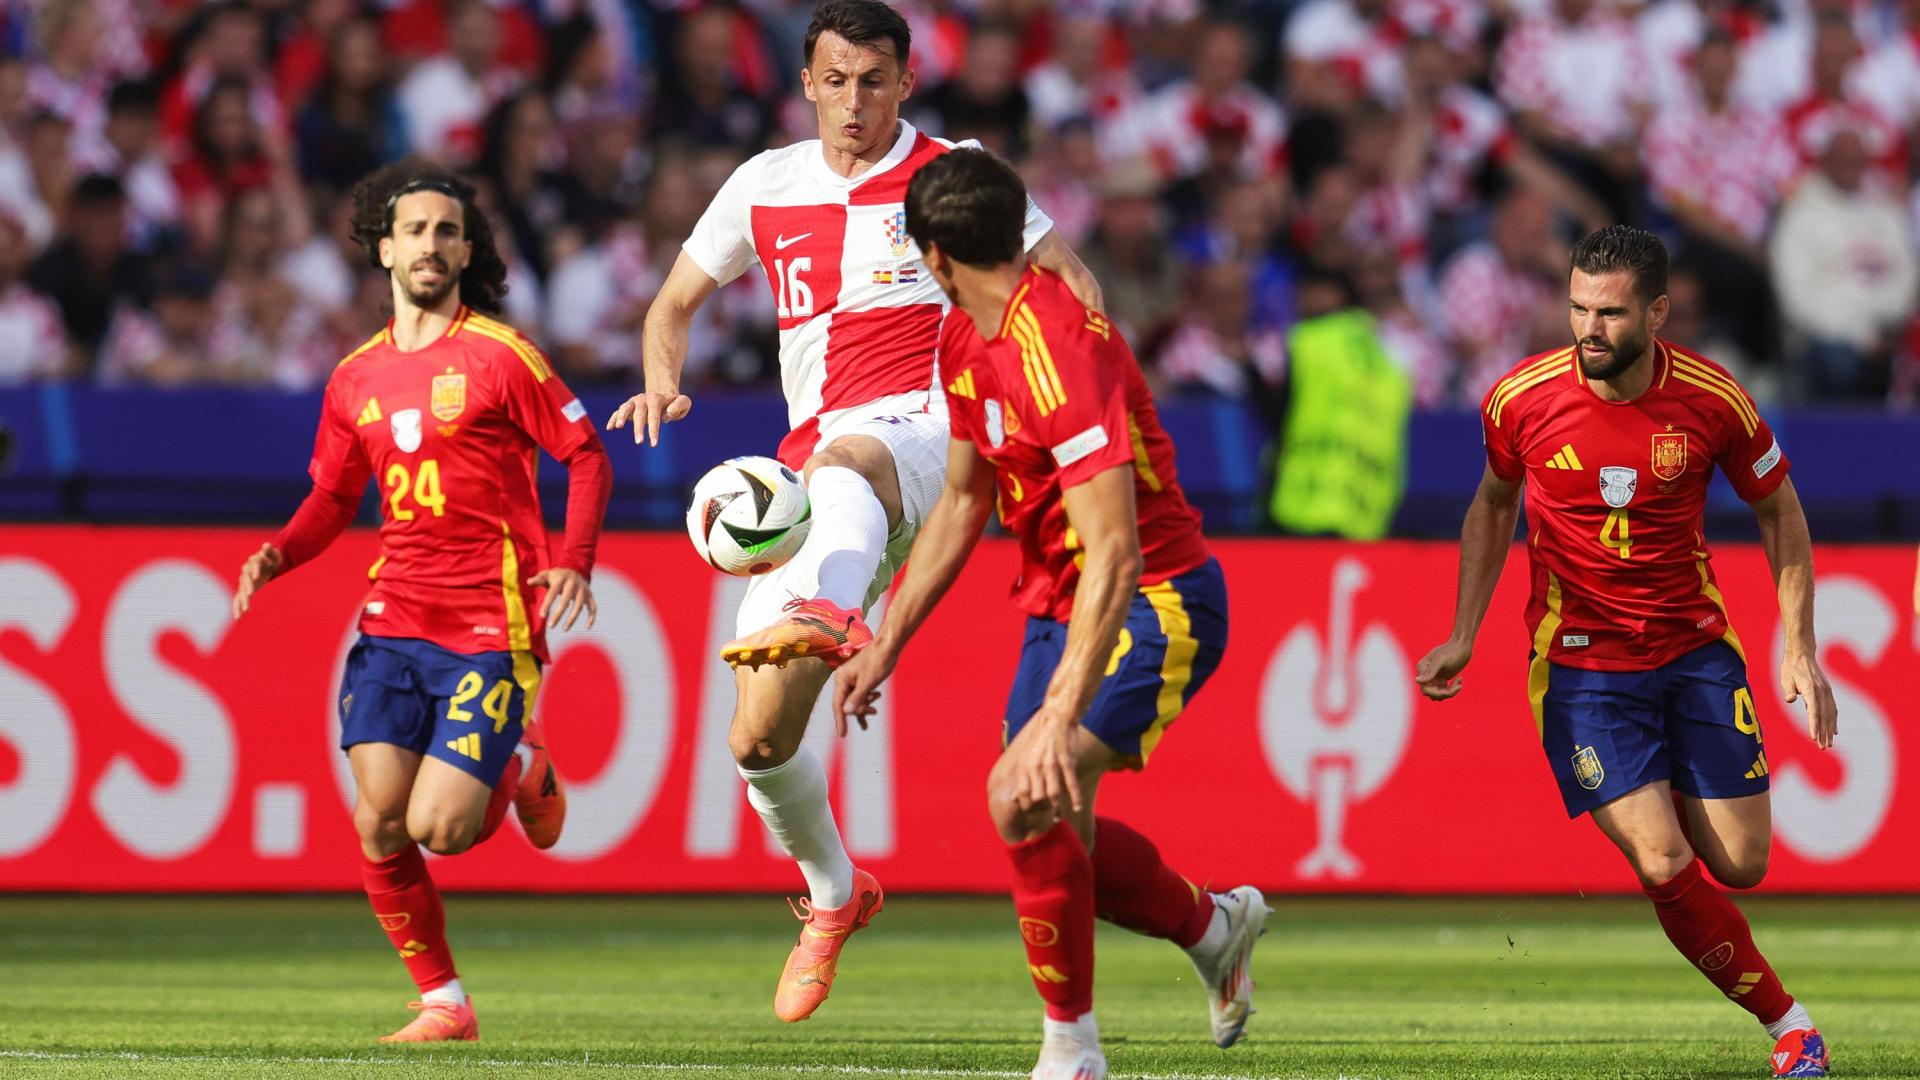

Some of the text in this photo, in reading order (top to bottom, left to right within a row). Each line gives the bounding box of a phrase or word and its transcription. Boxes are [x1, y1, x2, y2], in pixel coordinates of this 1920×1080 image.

[774, 257, 814, 318] 16
[386, 459, 446, 521] 24
[1600, 508, 1634, 559] 4
[0, 556, 897, 863] SS.OM
[446, 671, 513, 734] 24
[1735, 686, 1762, 745] 4
[1771, 573, 1920, 864] S
